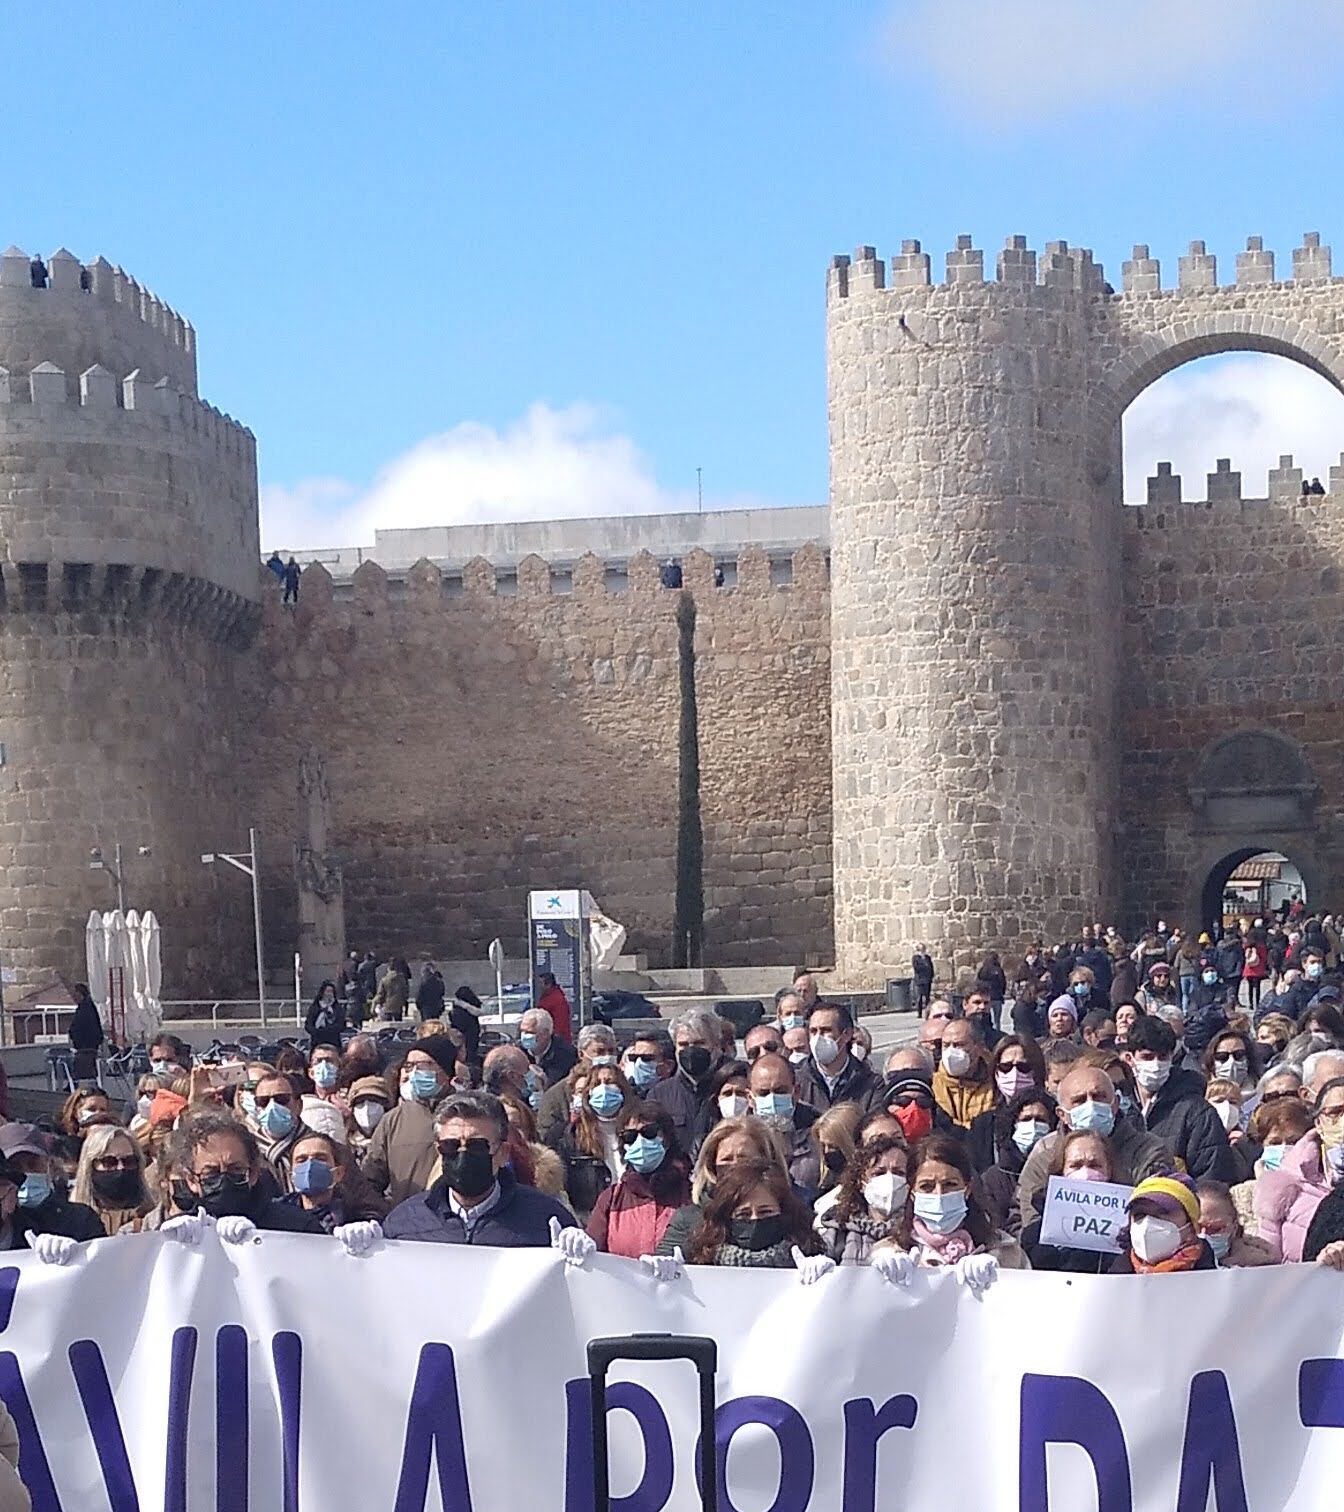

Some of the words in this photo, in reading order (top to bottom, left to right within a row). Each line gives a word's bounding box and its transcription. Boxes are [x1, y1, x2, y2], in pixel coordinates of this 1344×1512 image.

[1055, 1187, 1090, 1204] ÁVILA
[1094, 1195, 1118, 1208] POR
[1073, 1215, 1112, 1236] PAZ
